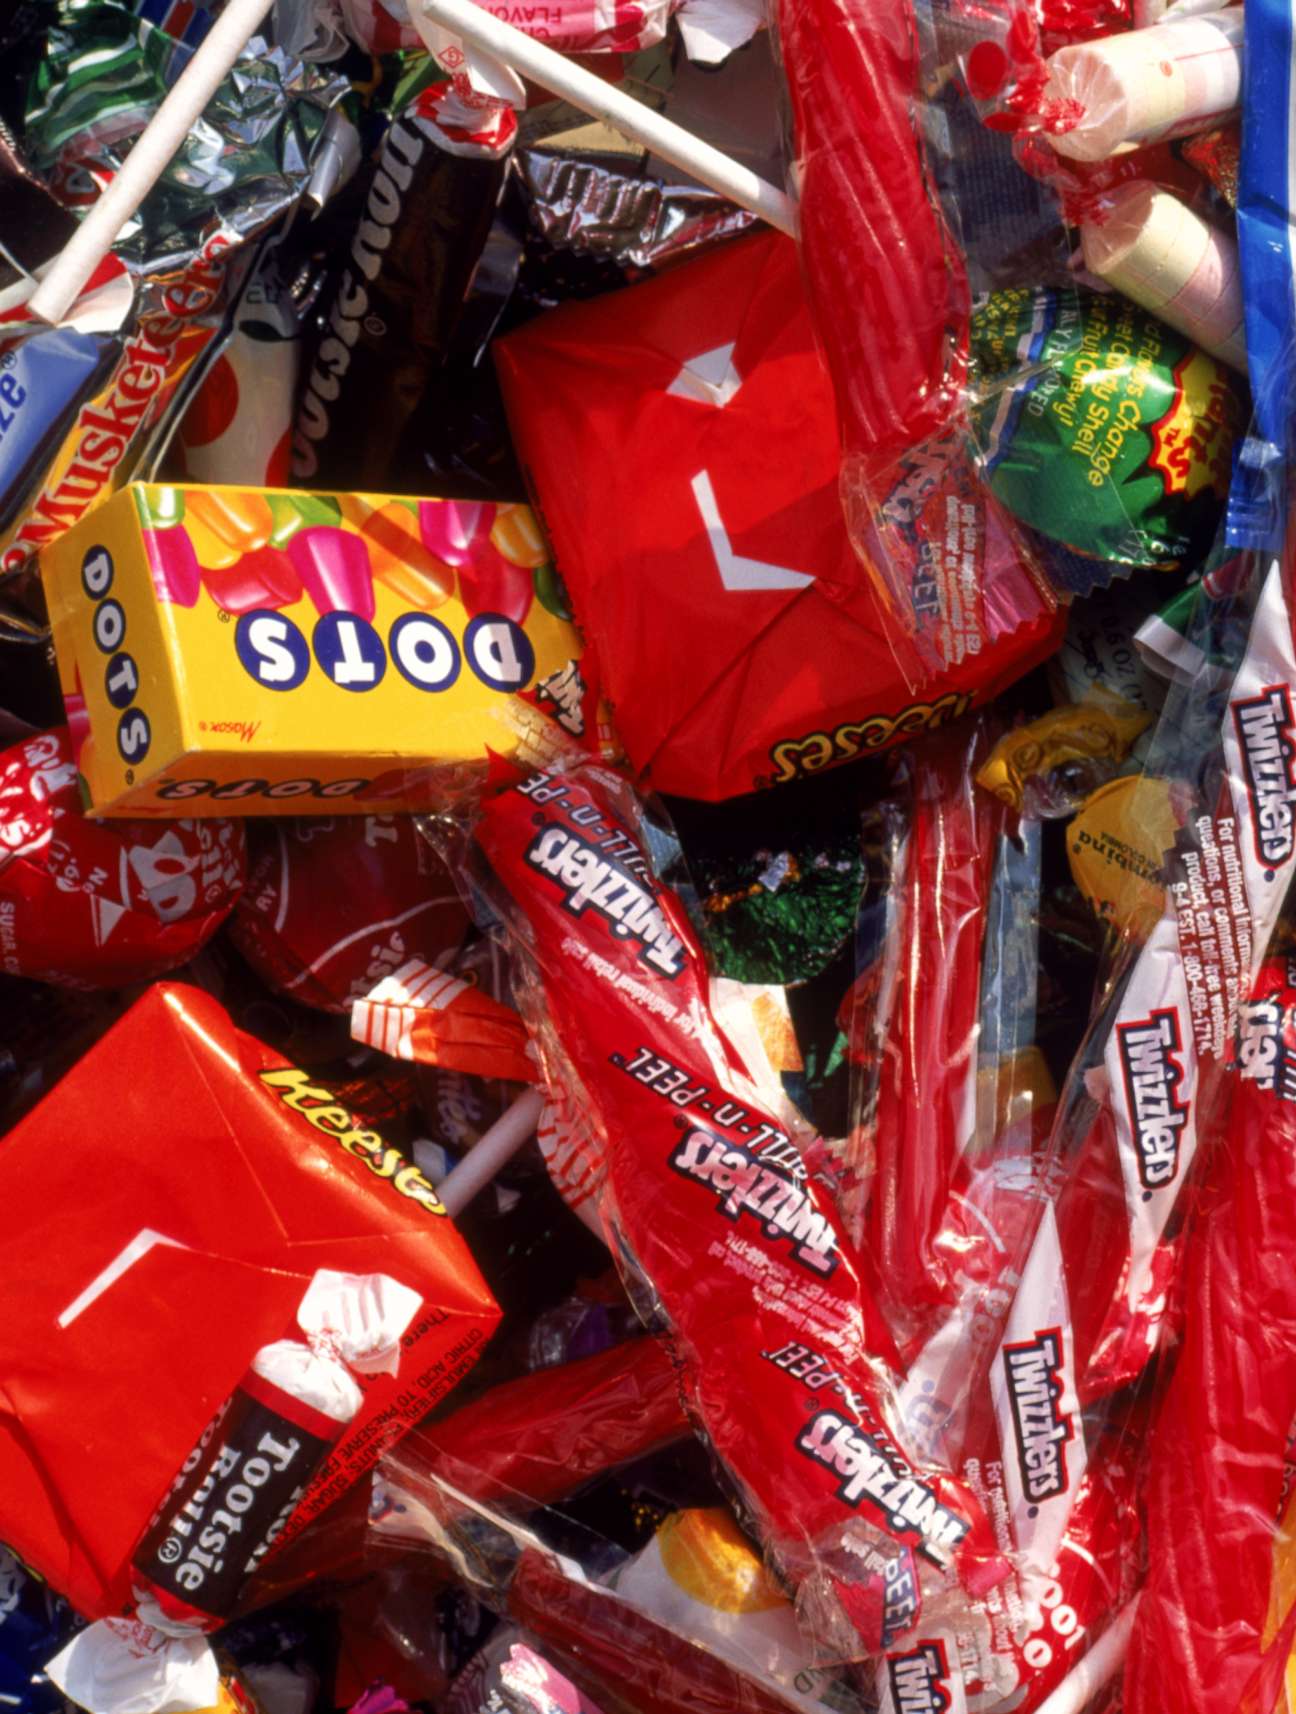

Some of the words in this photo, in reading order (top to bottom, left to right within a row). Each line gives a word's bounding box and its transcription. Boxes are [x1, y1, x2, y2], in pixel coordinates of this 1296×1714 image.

[1071, 402, 1110, 457] Shell
[1088, 400, 1142, 487] Change
[82, 548, 149, 760] DOTS
[245, 617, 528, 687] DOTS
[164, 780, 360, 799] DOTS
[1237, 693, 1294, 863] Twizzlers
[1195, 814, 1223, 888] questions,
[1217, 816, 1236, 844] For
[527, 825, 686, 977] Twizzlers
[1210, 888, 1226, 907] or
[1221, 844, 1249, 916] nutritional
[1195, 910, 1215, 940] call
[1213, 906, 1238, 979] comments
[1123, 1018, 1185, 1185] Twizzlers
[674, 1132, 841, 1273] Twizzlers
[403, 1307, 451, 1349] There
[443, 1326, 485, 1370] CITRIC
[1008, 1337, 1064, 1498] Twizzlers
[174, 1441, 243, 1543] Roll
[174, 1432, 301, 1593] Tootsie
